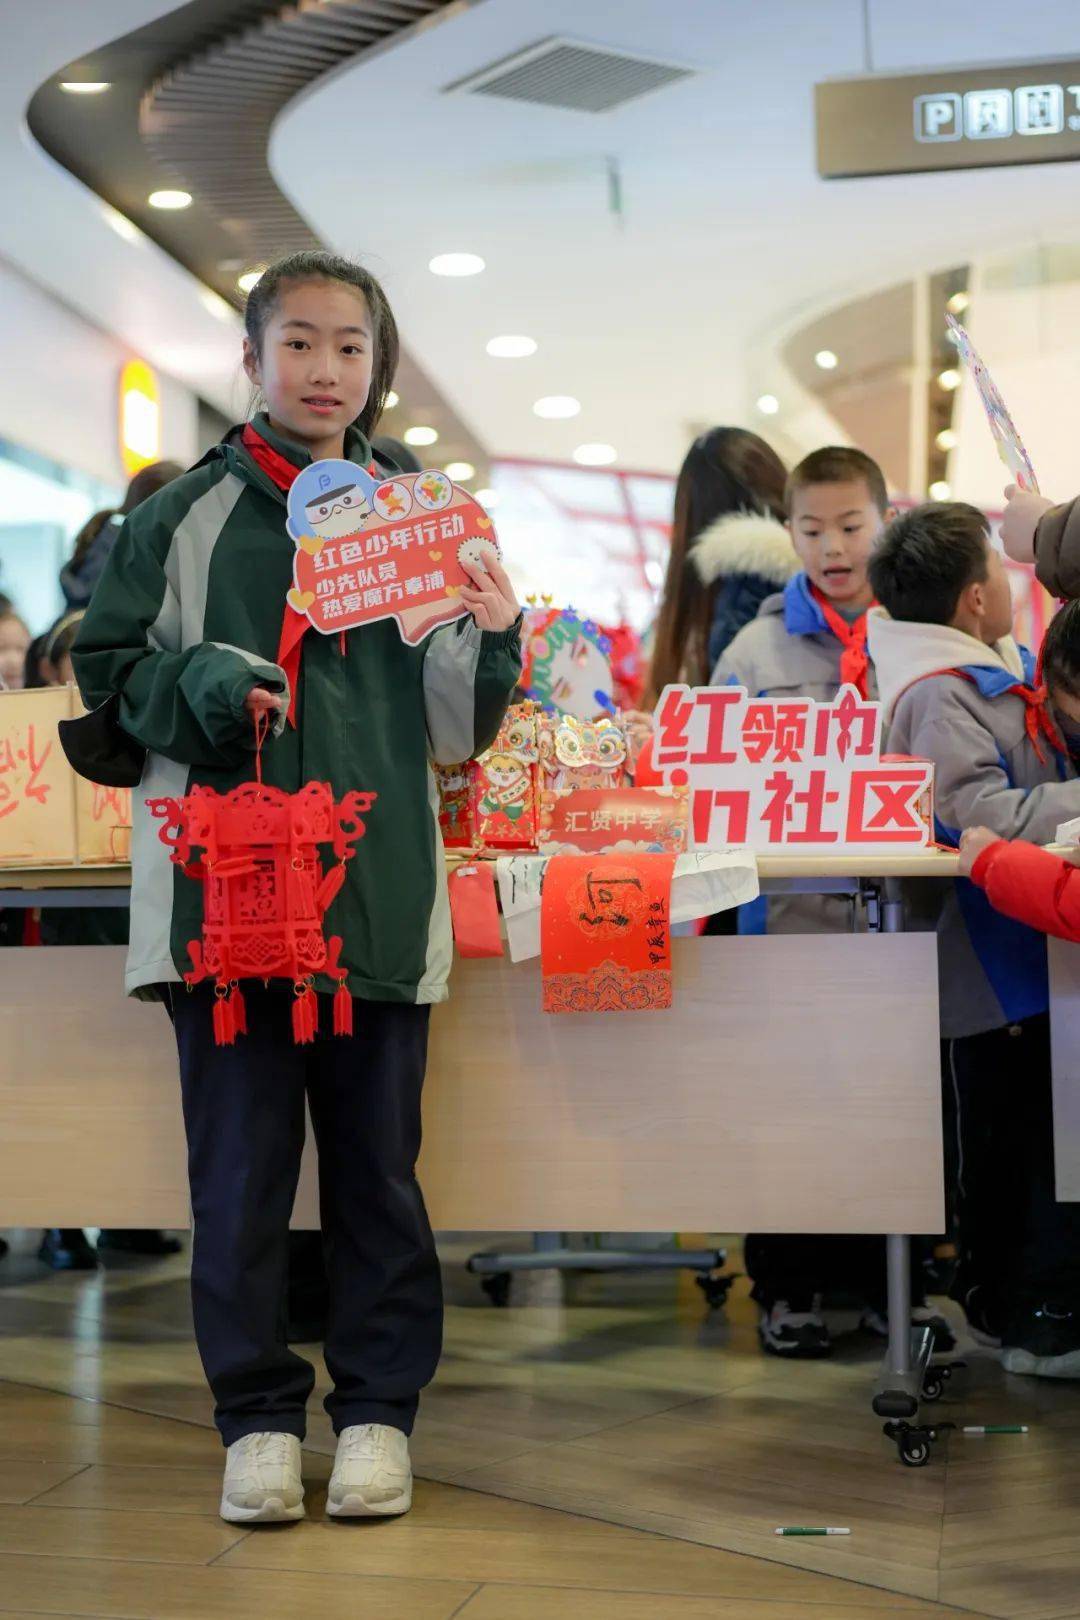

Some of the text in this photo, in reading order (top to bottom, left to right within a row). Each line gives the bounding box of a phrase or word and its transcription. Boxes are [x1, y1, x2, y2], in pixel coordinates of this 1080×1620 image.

[924, 101, 954, 137] P
[313, 513, 465, 573] 红色少年行动
[316, 561, 398, 599] 少先队员
[658, 690, 878, 764] 红领巾
[565, 808, 662, 832] 汇贤中学
[669, 768, 927, 843] n社区
